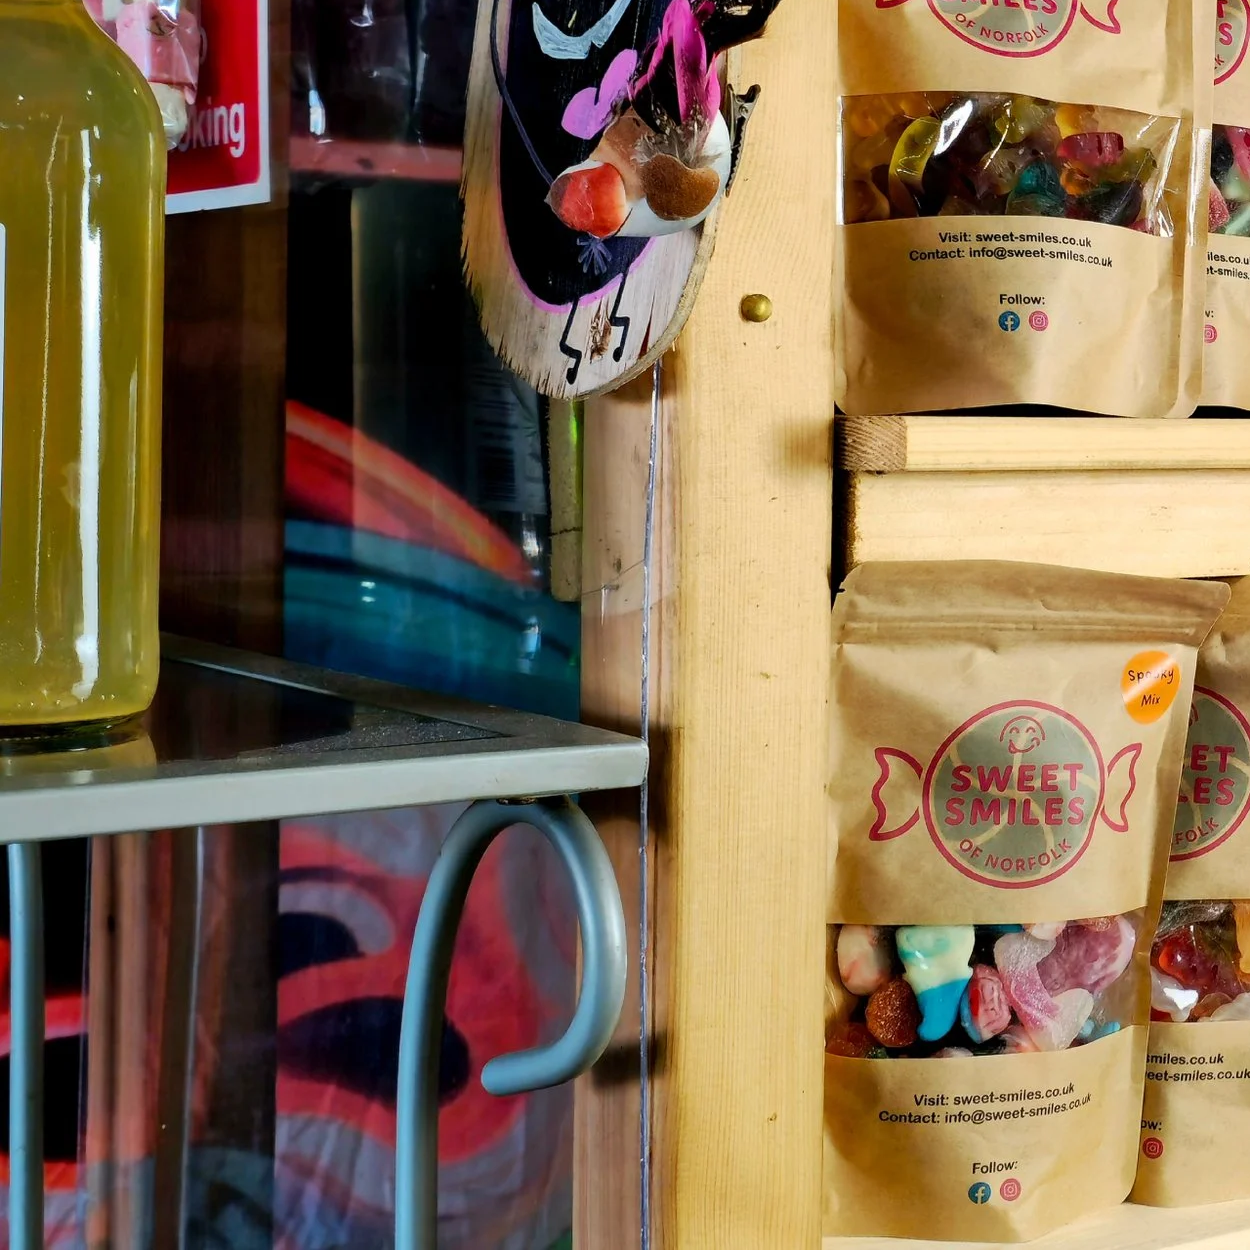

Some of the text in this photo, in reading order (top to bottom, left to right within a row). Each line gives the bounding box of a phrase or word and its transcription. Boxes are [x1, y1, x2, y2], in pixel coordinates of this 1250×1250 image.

[955, 12, 1049, 44] OF NORFOLK
[939, 232, 1092, 248] Visit: sweet-smiles.co.uk
[909, 246, 1113, 268] Contact: info@sweet-smiles.co.uk
[999, 293, 1046, 306] Follow:
[1140, 694, 1160, 707] Mix
[951, 763, 1084, 793] SWEET
[944, 796, 1085, 826] SMILES
[959, 838, 1072, 872] OF NORFOLK
[1146, 1068, 1250, 1082] eet-smiles.co.uk
[914, 1082, 1074, 1107] Visit: sweet-smiles.co.uk
[879, 1092, 1092, 1125] Contact: info@sweet-smiles.co.uk
[972, 1160, 1018, 1174] Follow:
